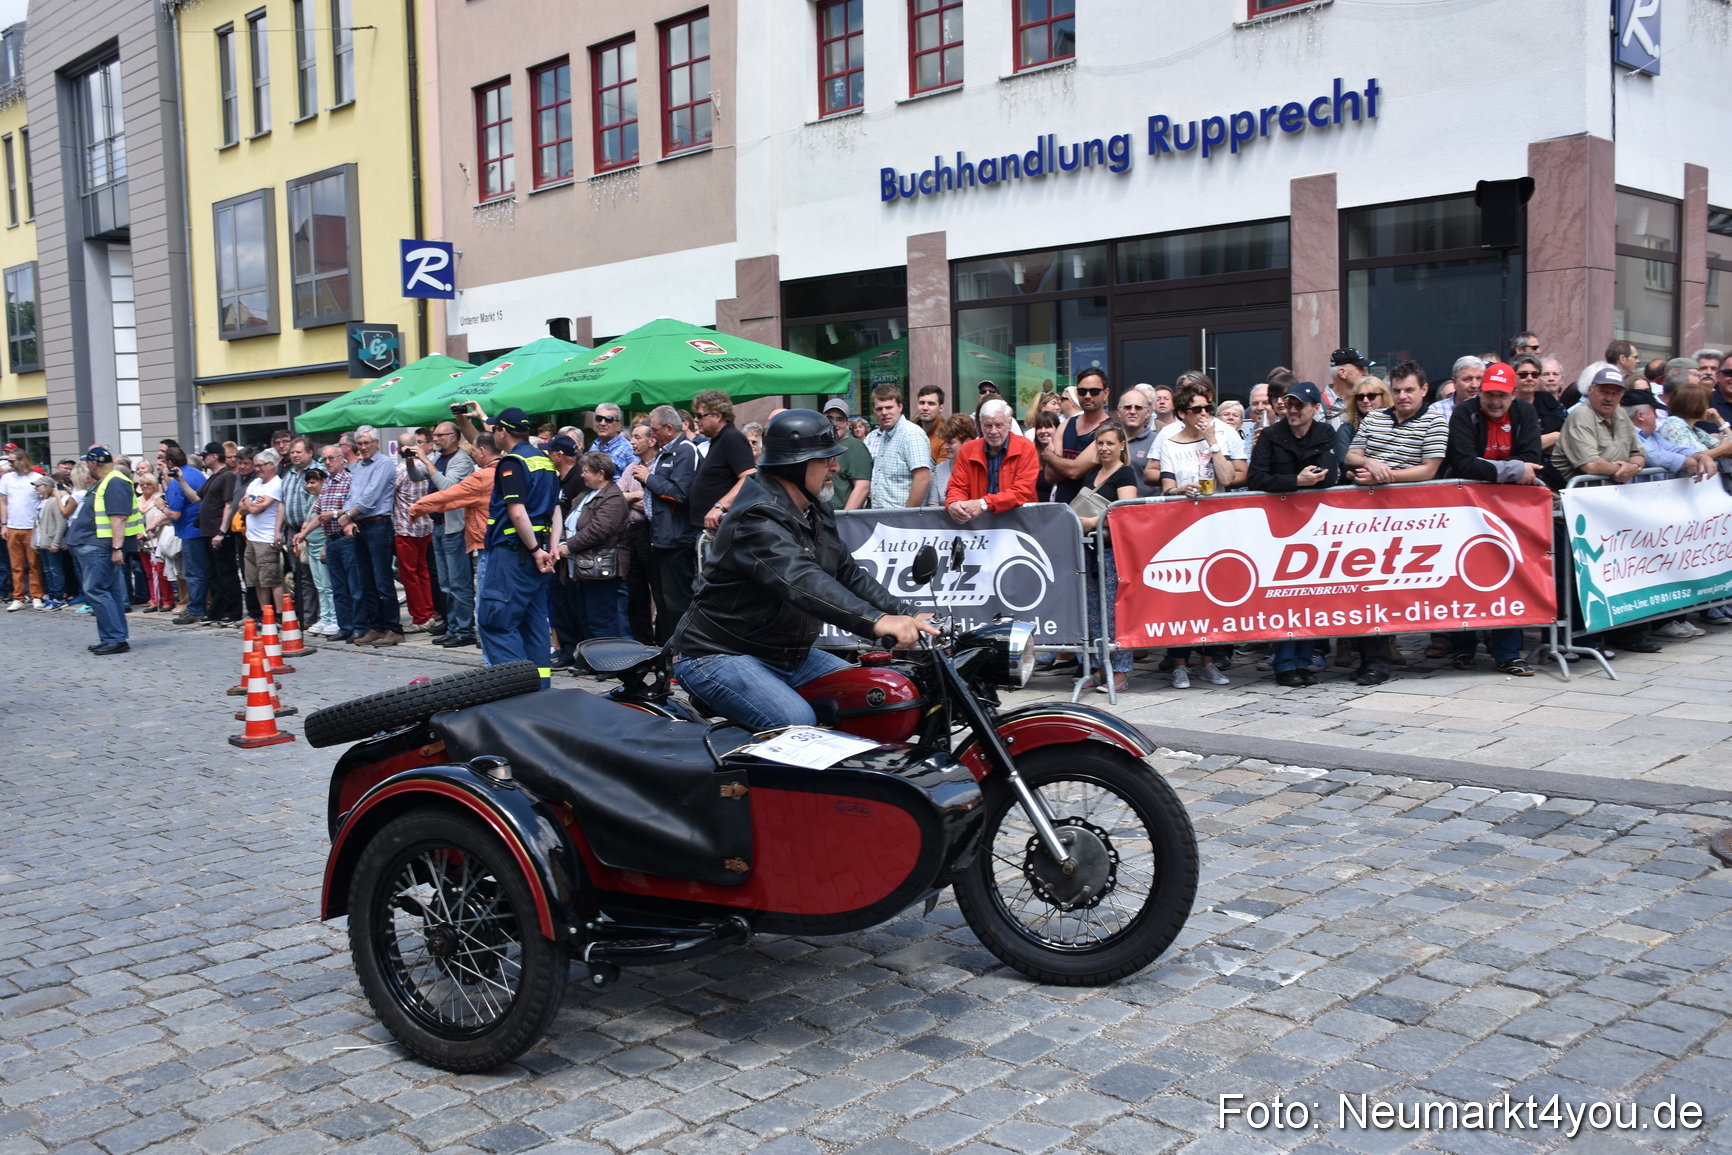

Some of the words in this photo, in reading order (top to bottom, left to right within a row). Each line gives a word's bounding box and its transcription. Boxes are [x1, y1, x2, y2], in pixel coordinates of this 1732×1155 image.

[880, 134, 1132, 202] Buchhandlung
[1147, 77, 1382, 158] Rupprecht
[460, 314, 480, 326] Unterer
[480, 311, 496, 324] Markt
[496, 310, 503, 321] 15
[873, 374, 899, 383] GARTEN
[1313, 512, 1451, 537] Autoklassik
[1631, 524, 1674, 548] UNS
[1272, 536, 1443, 581] Dietz
[1265, 585, 1360, 598] BREITENBRUNN
[1145, 597, 1527, 637] www.autoklassik-dietz.de
